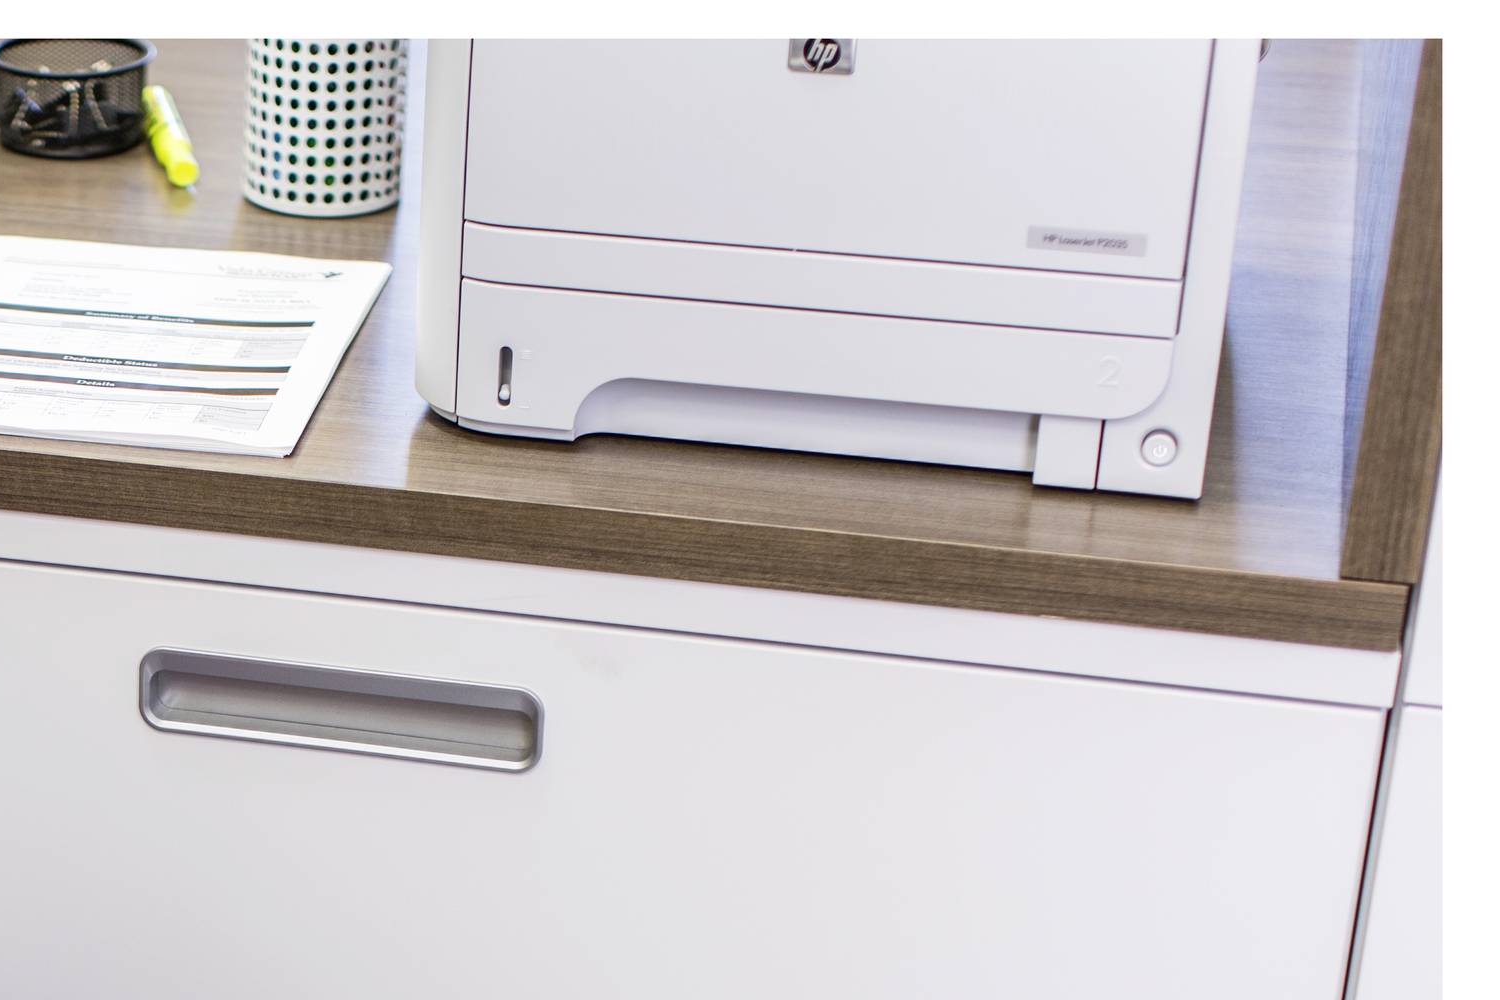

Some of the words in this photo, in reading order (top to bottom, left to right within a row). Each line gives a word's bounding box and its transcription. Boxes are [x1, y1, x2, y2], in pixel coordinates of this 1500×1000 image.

[806, 38, 839, 72] hp
[1043, 233, 1059, 244] HP
[62, 355, 122, 365] Deductible
[76, 379, 116, 387] Details
